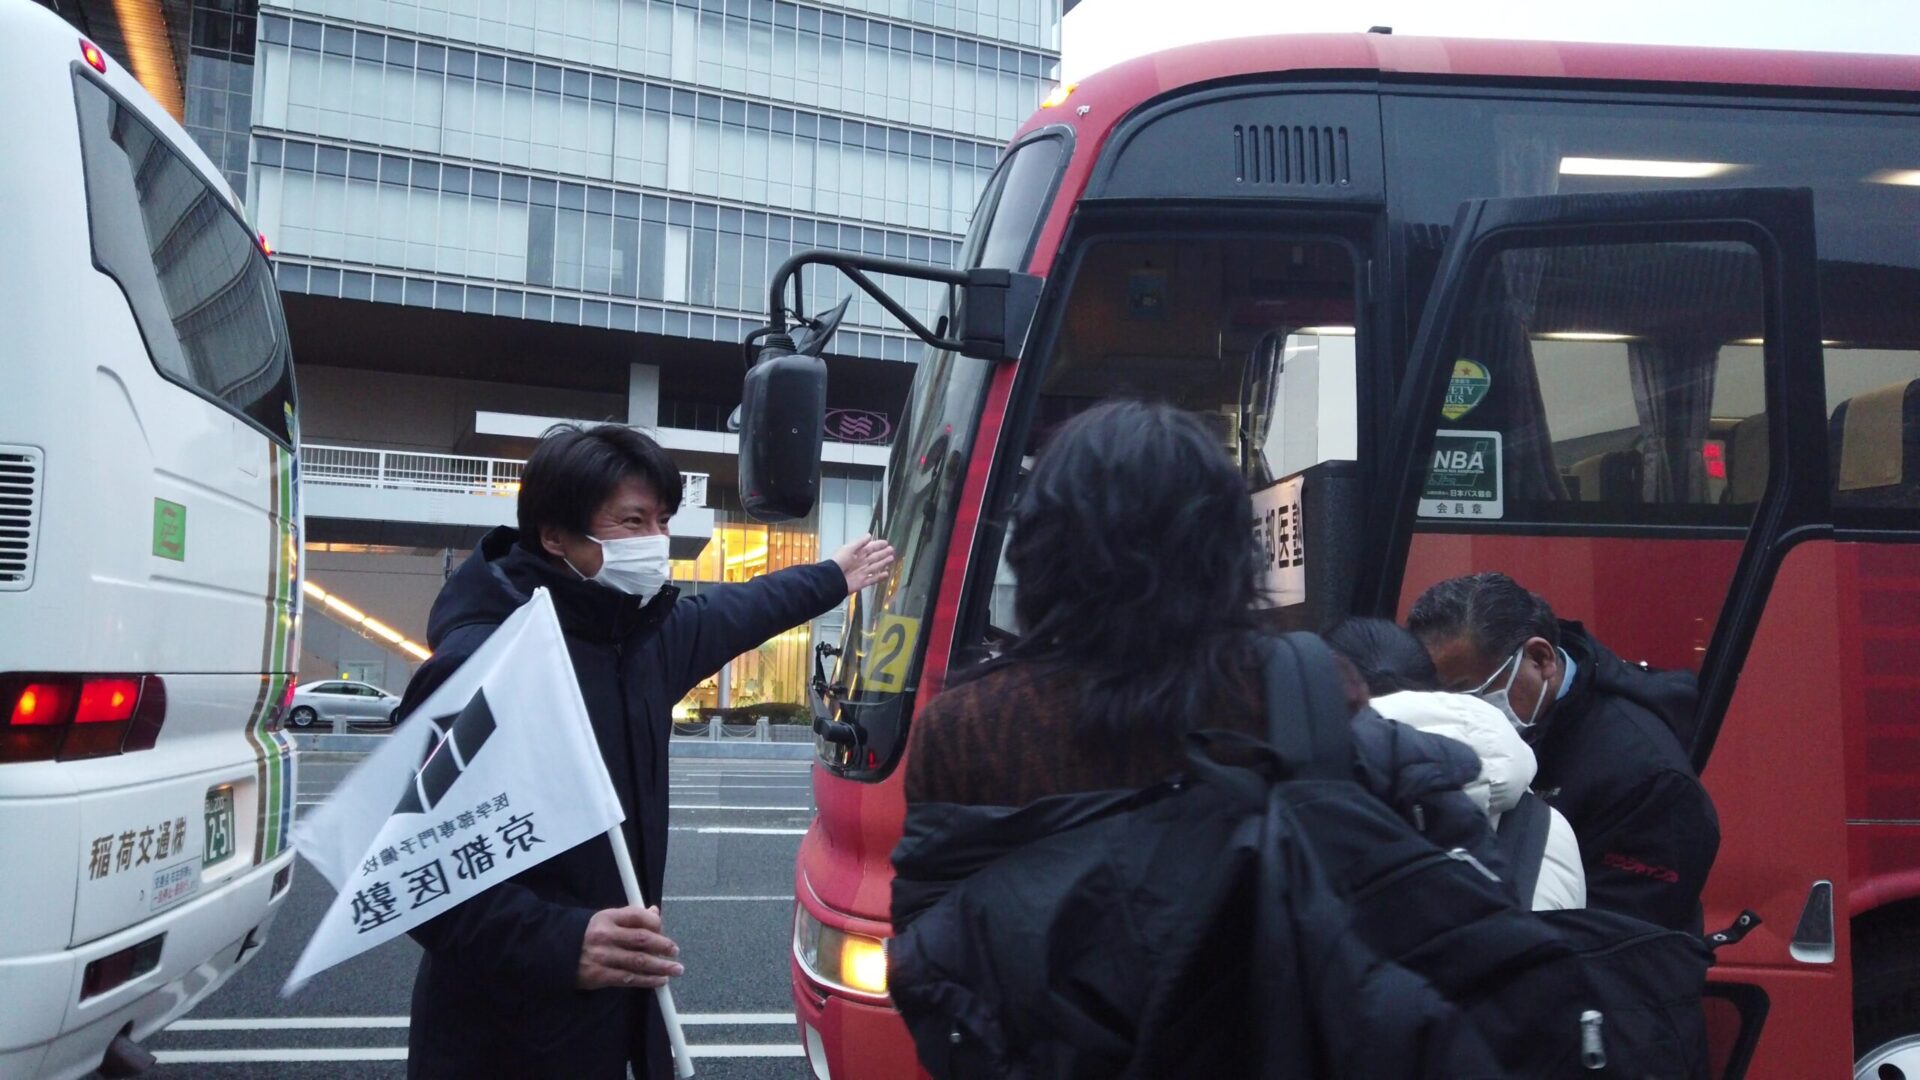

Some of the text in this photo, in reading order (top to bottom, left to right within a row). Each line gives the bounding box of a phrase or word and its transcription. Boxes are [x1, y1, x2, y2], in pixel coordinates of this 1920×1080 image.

[1447, 386, 1474, 395] ETY
[1433, 450, 1484, 470] NBA
[1436, 502, 1482, 514] 会員章
[870, 623, 905, 685] 2
